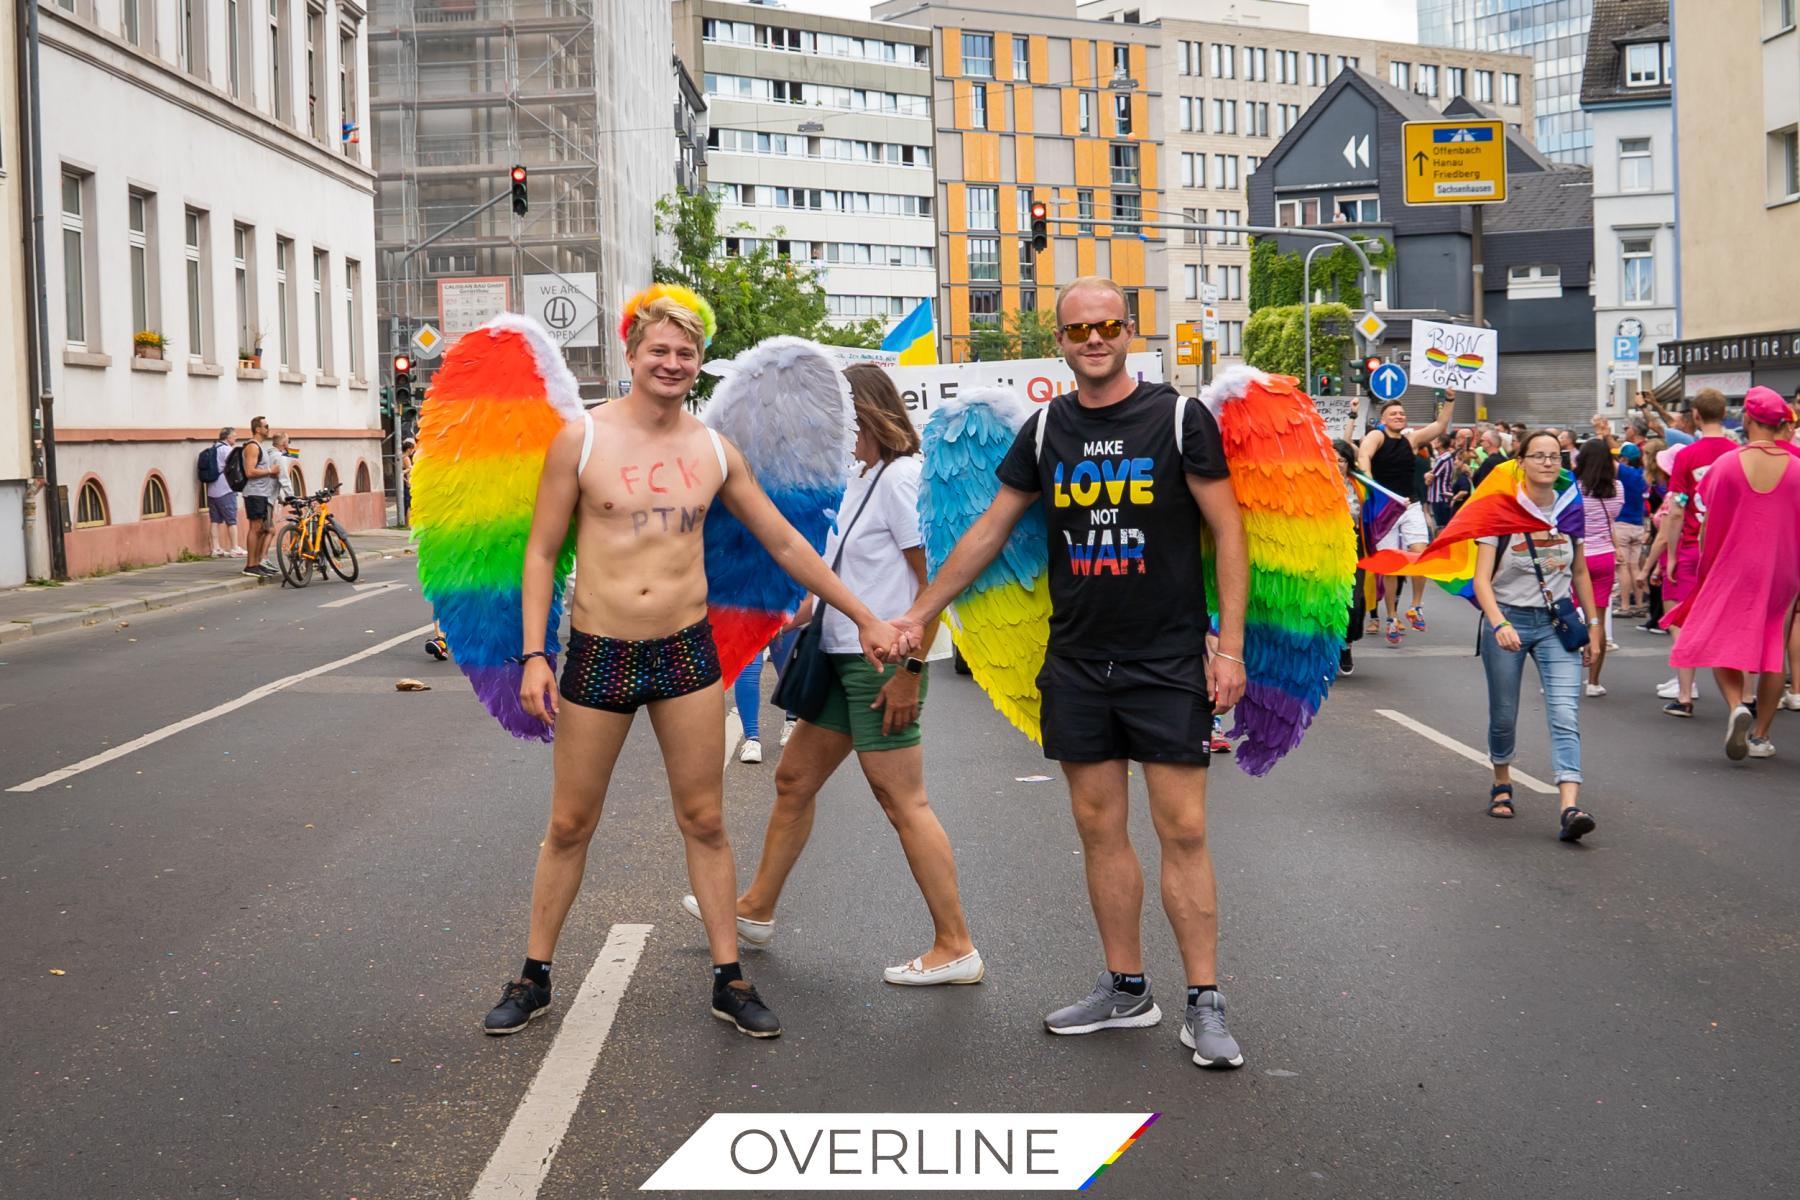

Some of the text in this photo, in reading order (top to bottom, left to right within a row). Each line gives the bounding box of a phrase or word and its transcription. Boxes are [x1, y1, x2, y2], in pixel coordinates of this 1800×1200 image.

[1433, 146, 1481, 155] Offenbach
[1433, 159, 1463, 167] Hanau
[1433, 170, 1480, 180] Friedberg
[1437, 184, 1491, 194] Sachsenhausen
[540, 284, 580, 295] WE ARE
[1428, 327, 1484, 353] BORN
[1433, 369, 1473, 389] GAY
[901, 382, 928, 411] ei
[1083, 440, 1124, 457] MAKE
[619, 457, 703, 495] FCK
[1053, 457, 1154, 508] LOVE
[631, 506, 698, 537] PTN
[1090, 508, 1119, 525] NOT
[1062, 528, 1146, 577] WAR
